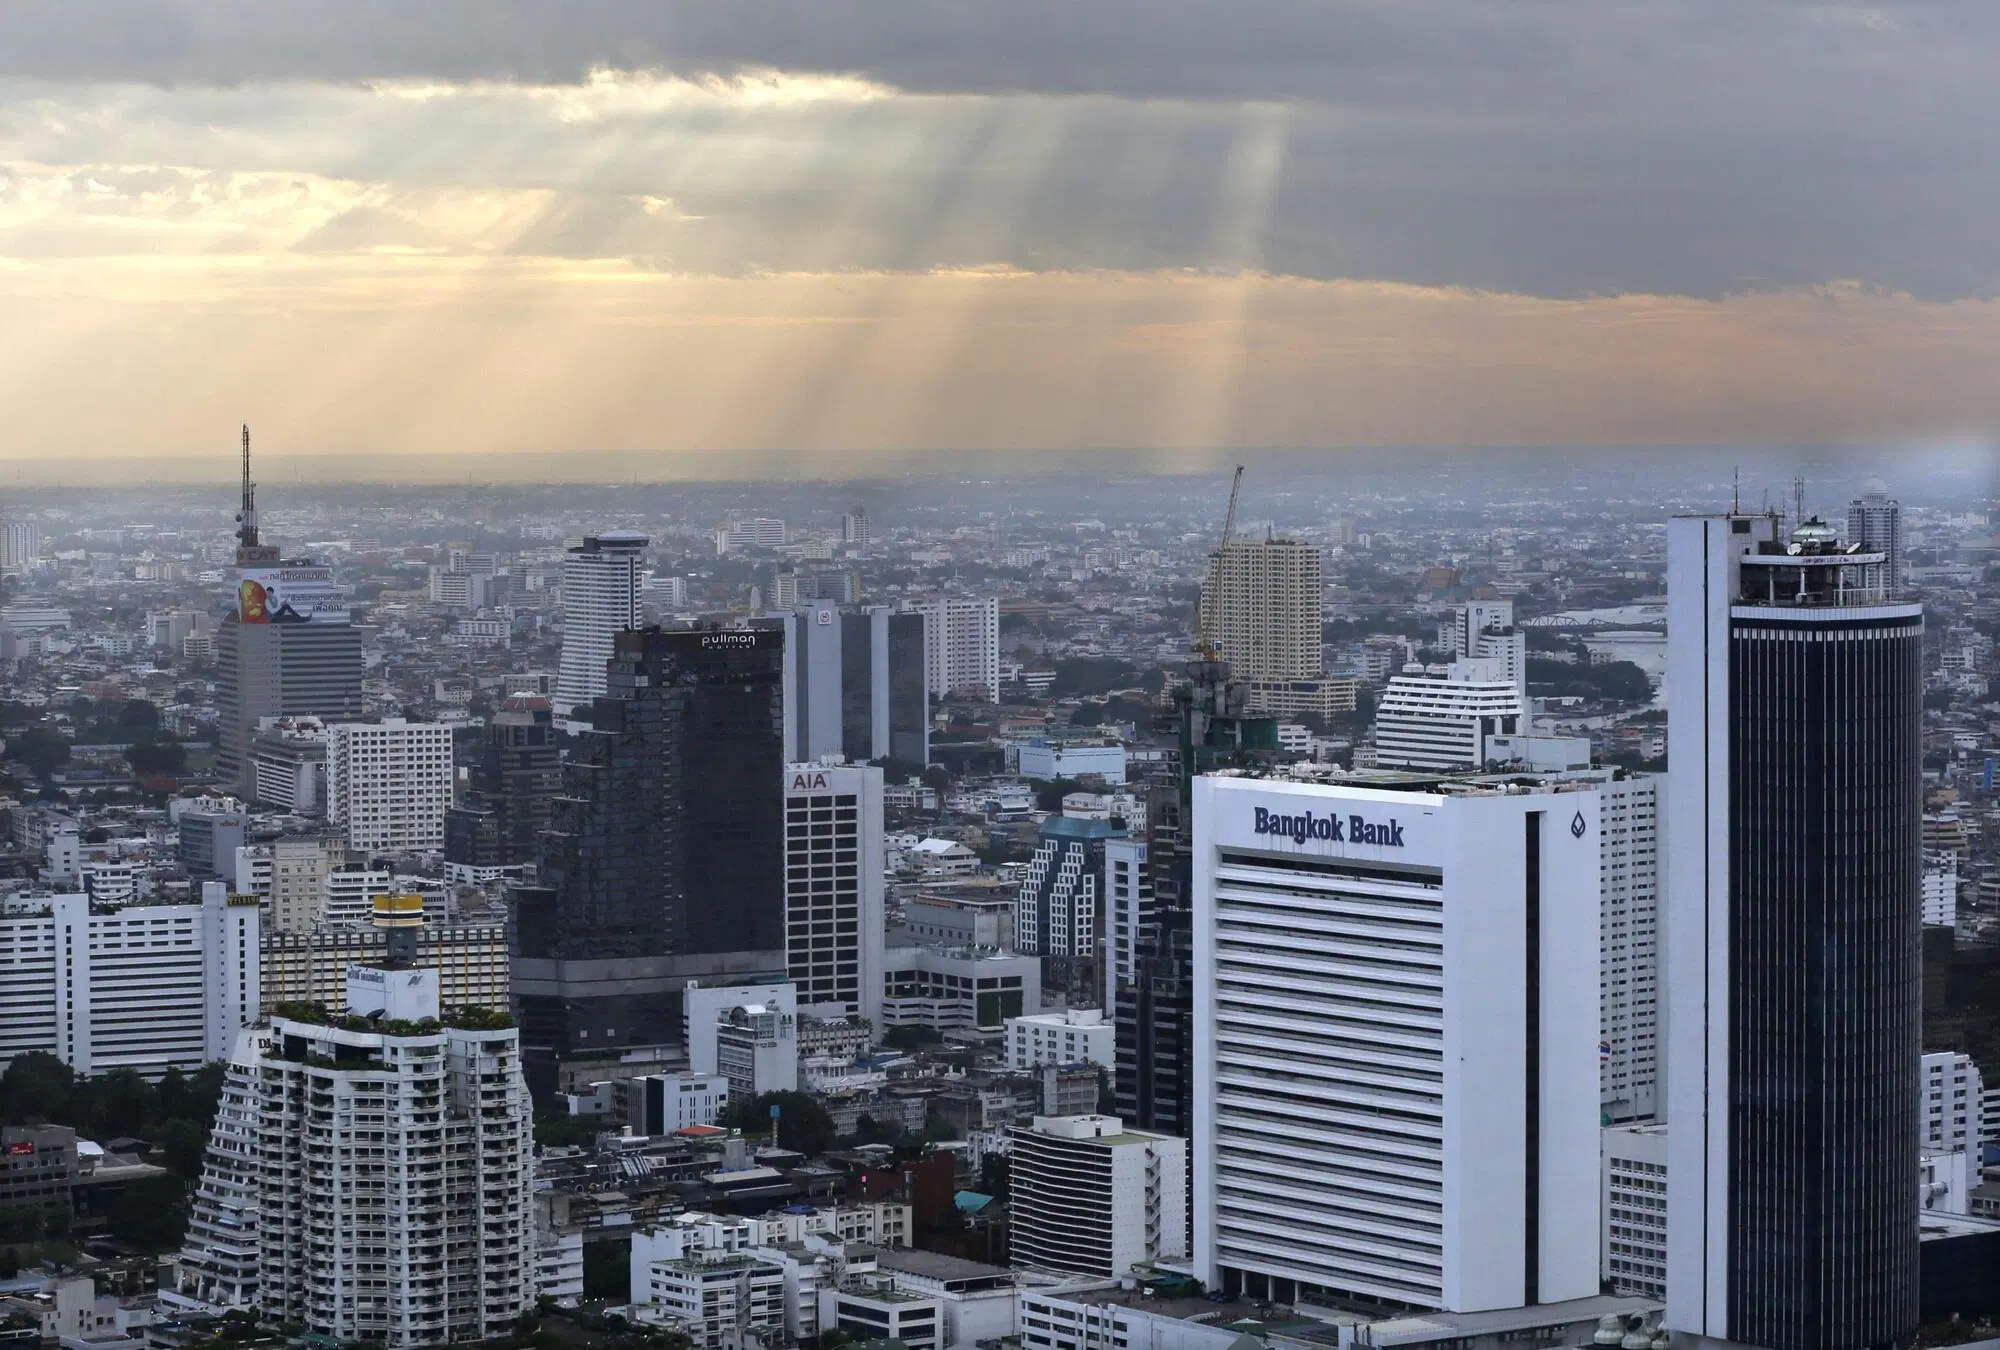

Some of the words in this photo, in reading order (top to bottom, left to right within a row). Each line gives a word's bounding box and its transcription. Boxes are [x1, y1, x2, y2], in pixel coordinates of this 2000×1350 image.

[701, 634, 755, 647] pullman
[793, 773, 827, 789] AIA
[1254, 806, 1345, 845] Bangkok
[1349, 815, 1405, 847] Bank
